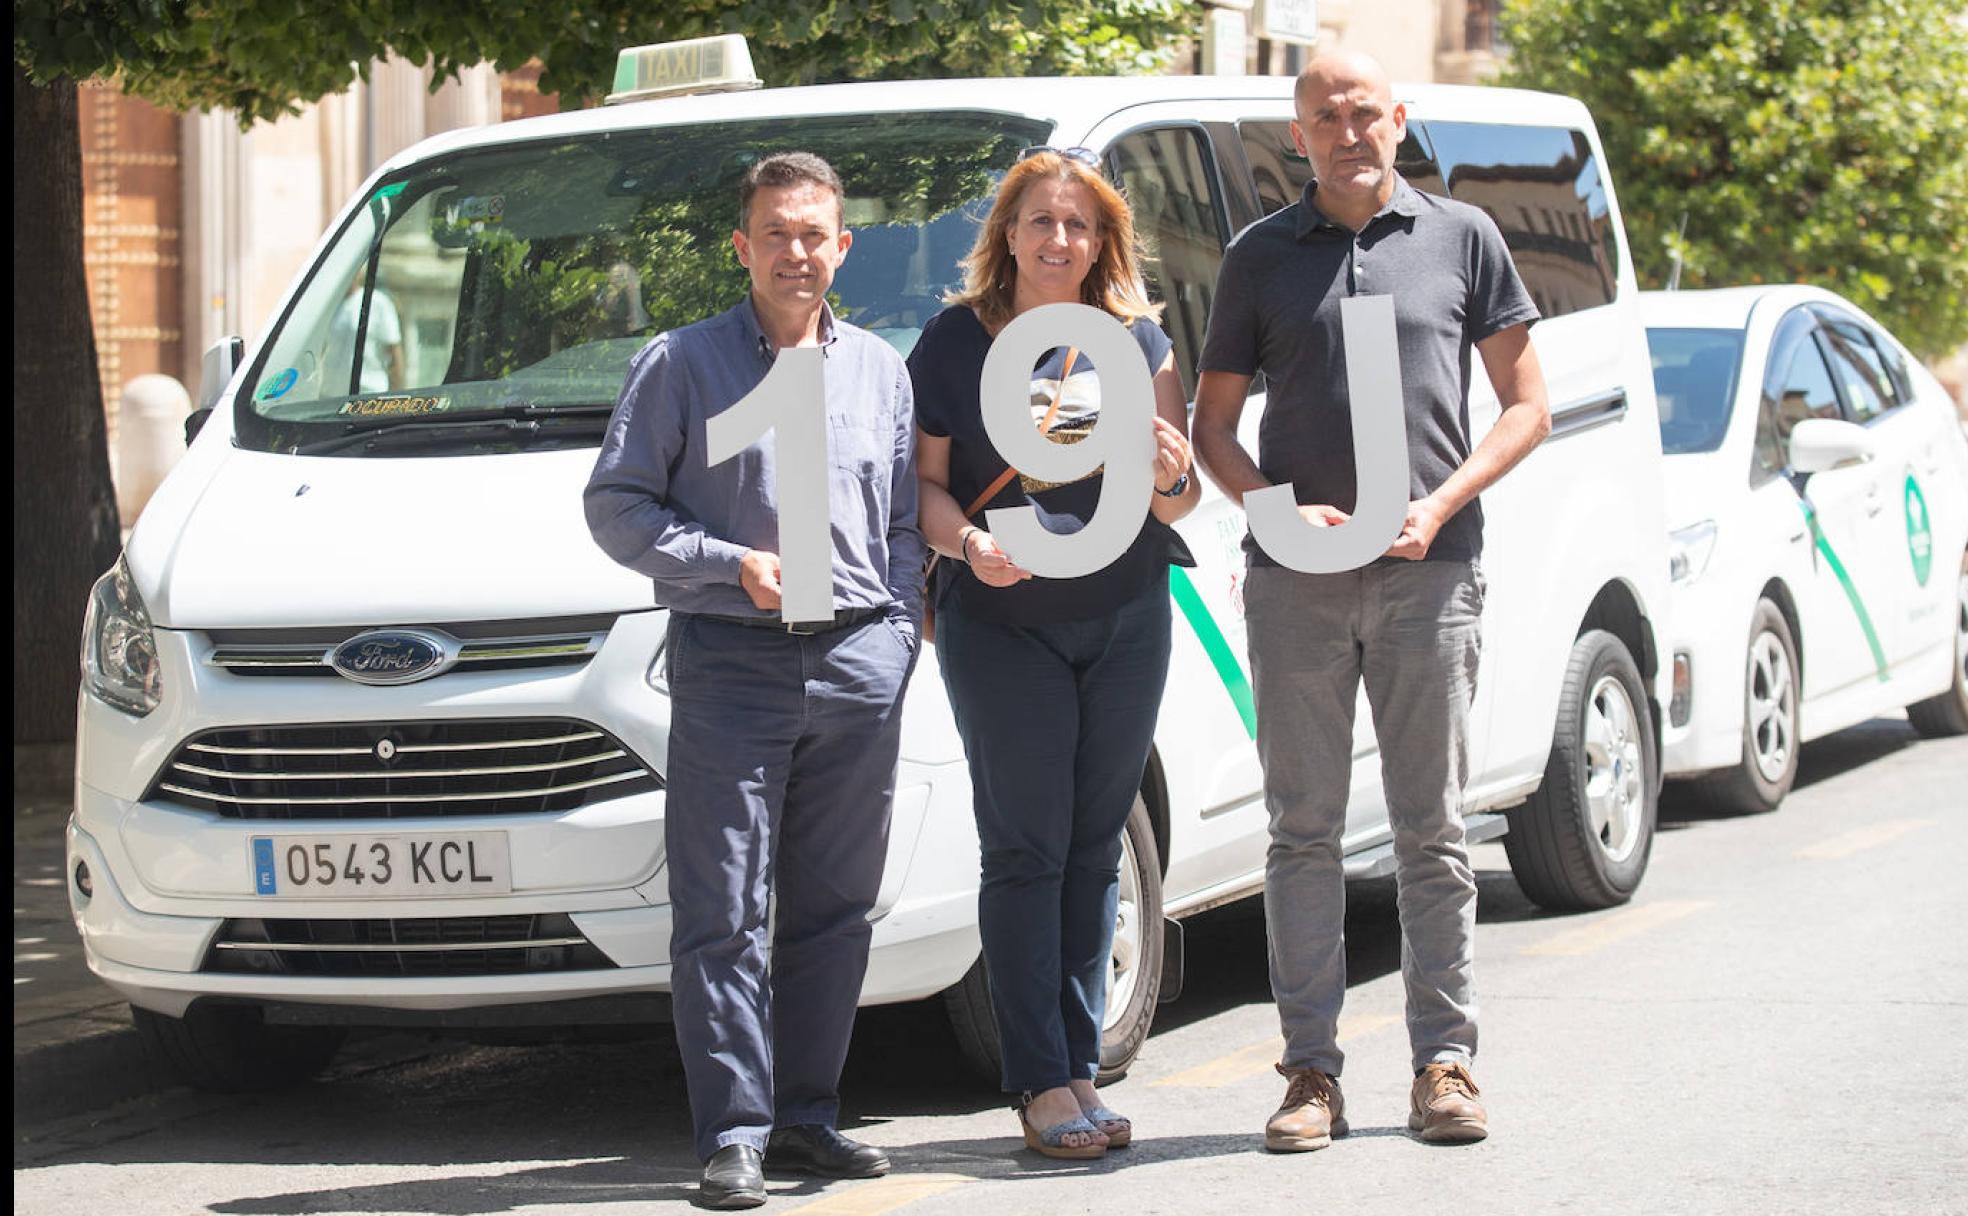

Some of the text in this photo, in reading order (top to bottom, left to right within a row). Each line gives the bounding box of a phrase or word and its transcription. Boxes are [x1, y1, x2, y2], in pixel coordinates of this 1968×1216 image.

[646, 47, 697, 81] TAXI
[354, 642, 415, 670] Ford
[287, 840, 493, 885] 0543 KCL
